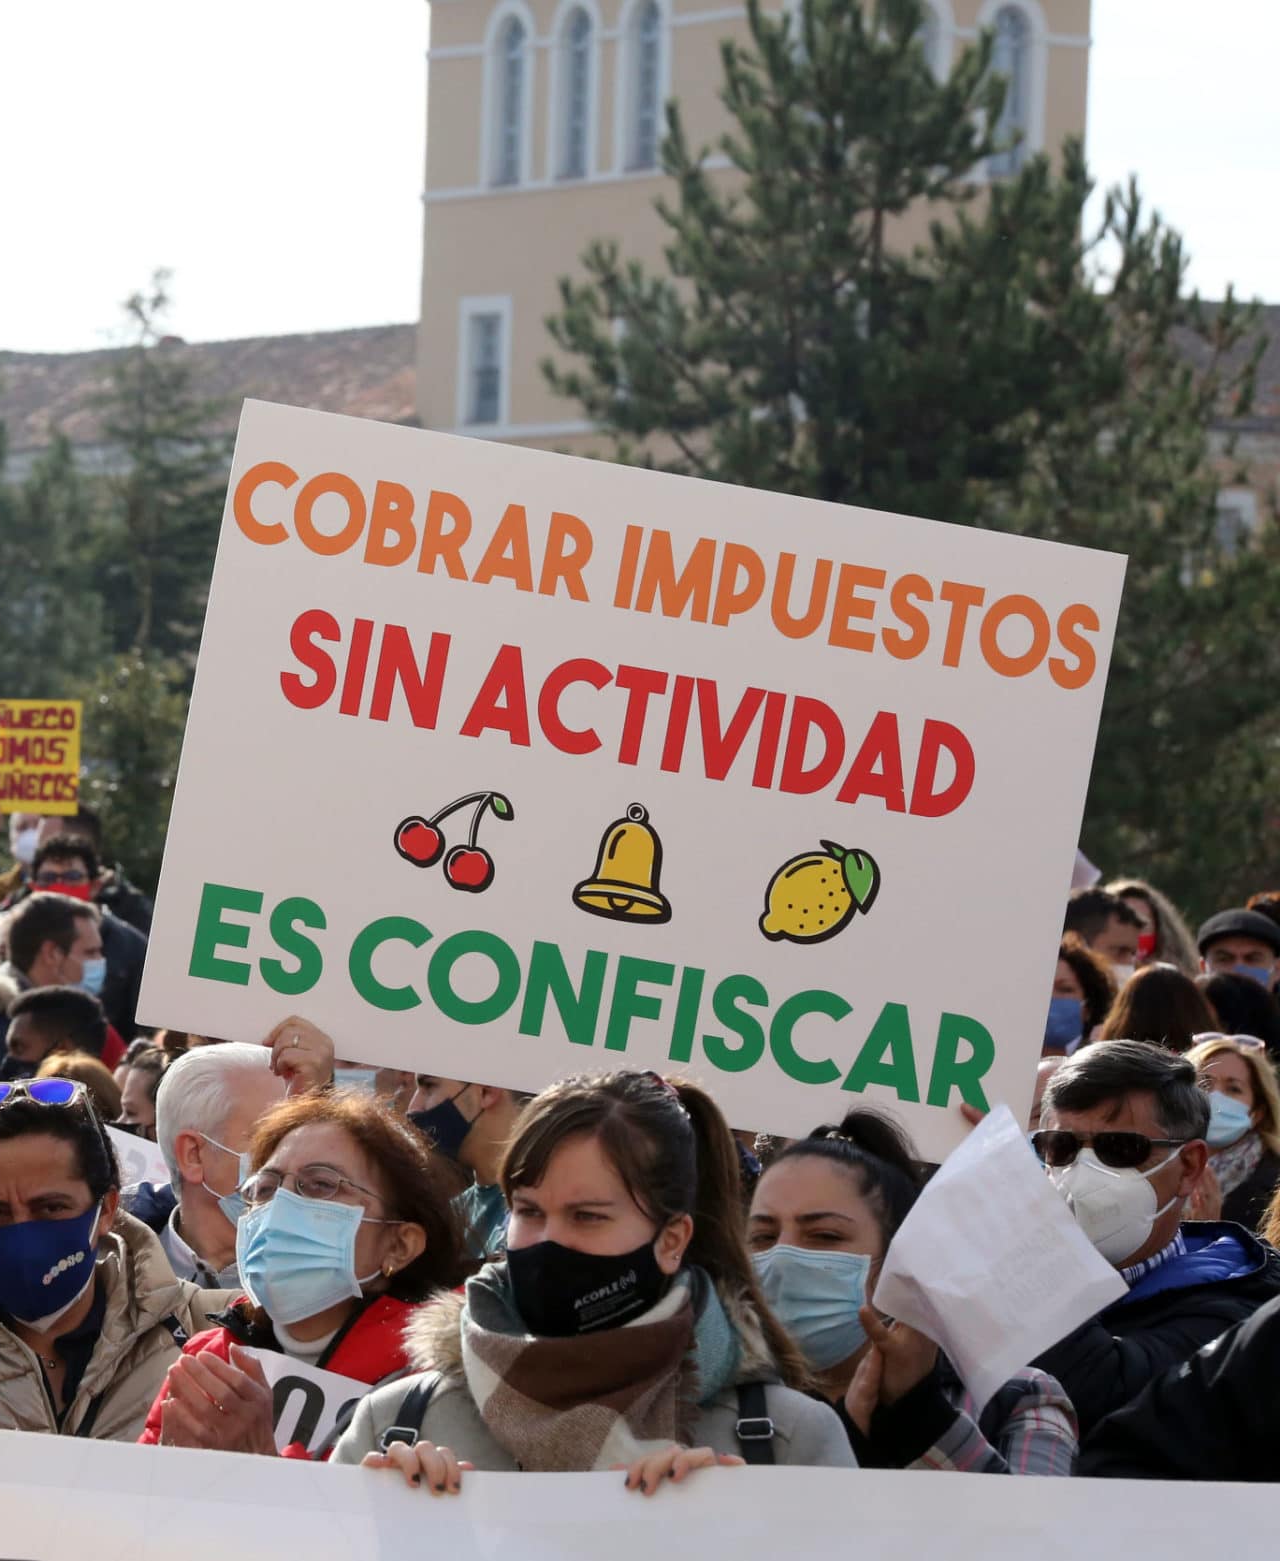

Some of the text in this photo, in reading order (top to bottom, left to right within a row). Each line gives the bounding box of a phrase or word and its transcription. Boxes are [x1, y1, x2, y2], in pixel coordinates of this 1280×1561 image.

[233, 461, 1100, 690] COBRAR IMPUESTOS
[280, 609, 976, 818] SIN ACTIVIDAD
[188, 882, 995, 1114] ES CONFISCAR
[573, 1281, 620, 1310] ACOPLE
